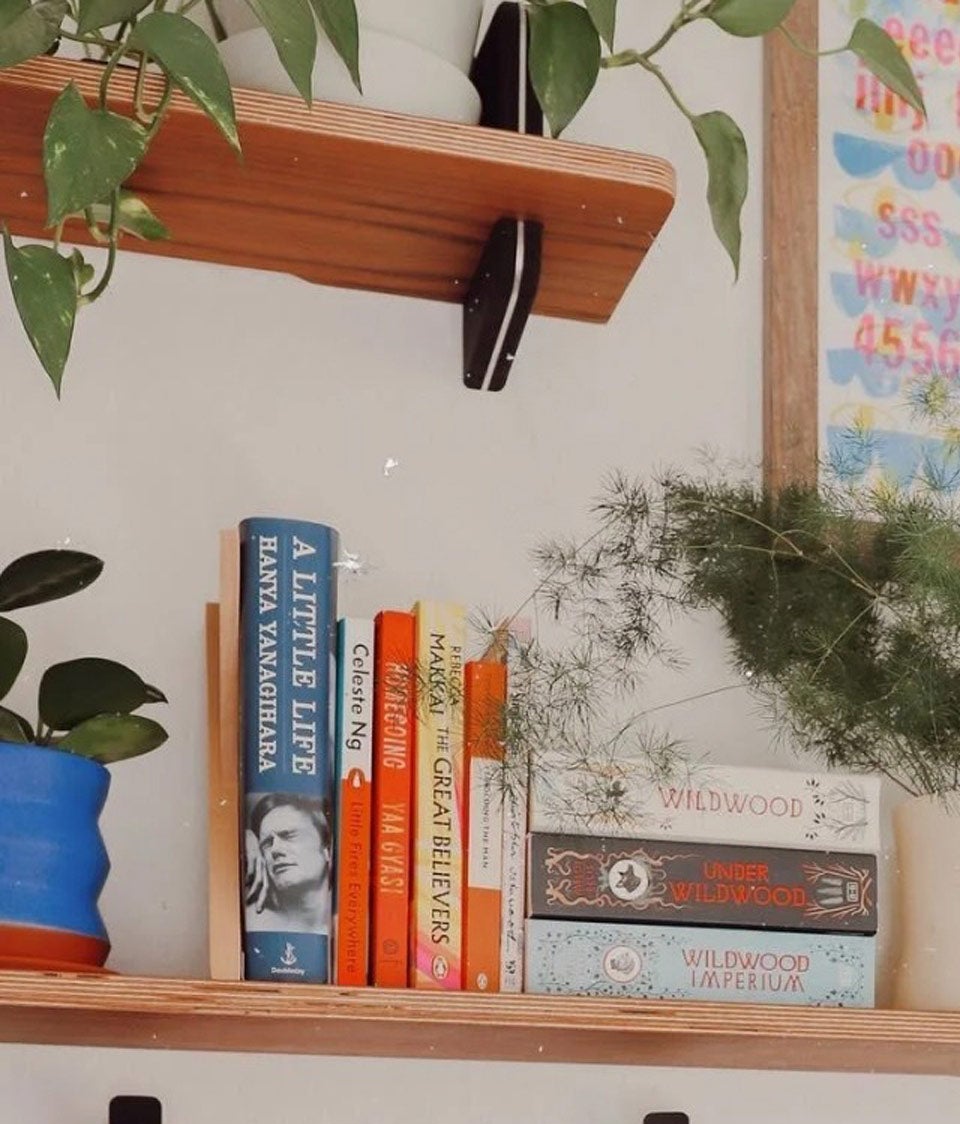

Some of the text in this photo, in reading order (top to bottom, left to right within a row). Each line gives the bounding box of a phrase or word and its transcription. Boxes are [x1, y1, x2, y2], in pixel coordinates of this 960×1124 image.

[868, 202, 943, 247] sss
[259, 535, 278, 774] HANYA YANAGIHARA
[292, 535, 317, 775] A LITTLE LIFE
[429, 633, 446, 715] MAKKAI
[346, 643, 369, 751] Celeste Ng
[431, 726, 453, 945] THE GREAT BELIEVERS
[658, 785, 804, 818] WILDWOOD
[380, 802, 405, 894] YAA GYASI
[703, 861, 769, 882] UNDER
[346, 883, 361, 974] Everywhere
[669, 881, 807, 907] WILDWOOD
[682, 949, 811, 973] WILDWOOD
[691, 971, 805, 993] IMPERIUM
